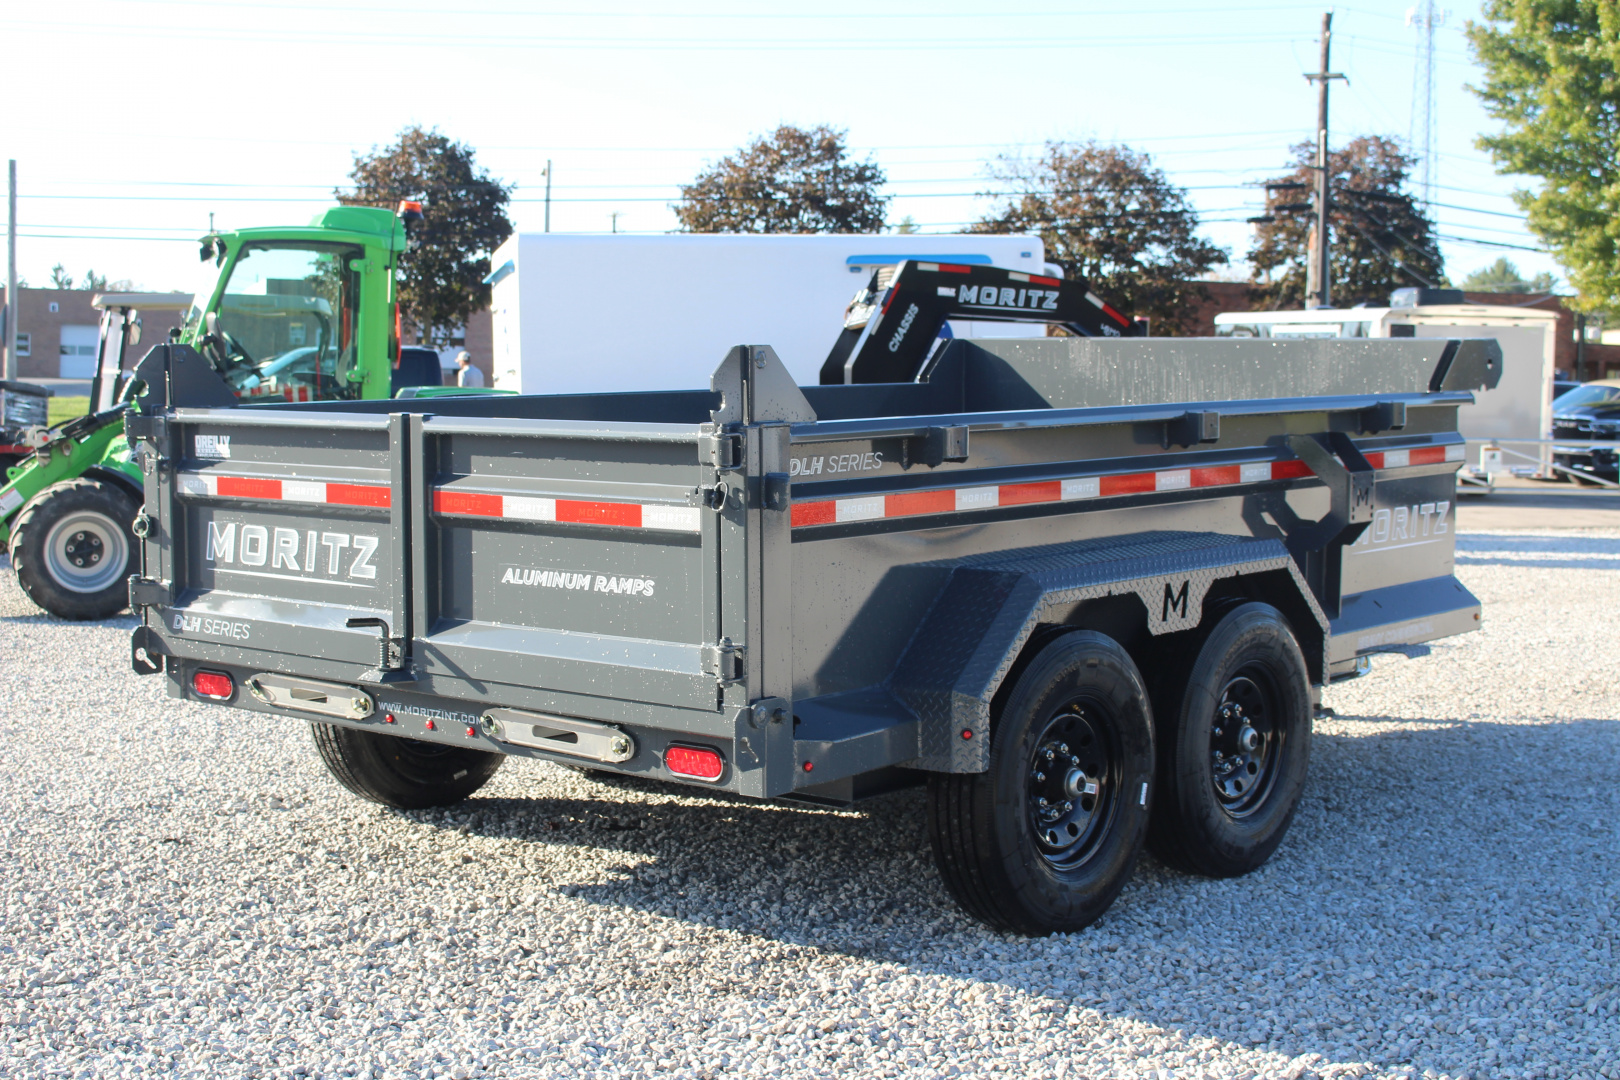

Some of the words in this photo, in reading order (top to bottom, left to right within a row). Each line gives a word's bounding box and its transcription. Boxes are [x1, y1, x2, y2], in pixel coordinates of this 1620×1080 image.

[958, 284, 1060, 310] MORITZ
[888, 302, 919, 352] CHASSIS
[789, 456, 825, 477] DLH
[826, 451, 884, 473] SERIES
[288, 486, 320, 497] MORITZ
[345, 490, 378, 501] MORITZ
[1065, 483, 1095, 494] MORITZ
[1356, 487, 1369, 507] M
[962, 492, 993, 503] MORITZ
[510, 501, 548, 514] MORITZ
[578, 507, 618, 520] MORITZ
[842, 502, 879, 515] MORITZ
[650, 511, 694, 525] MORITZ
[206, 521, 379, 579] MORITZ
[501, 568, 592, 591] ALUMINUM
[593, 575, 656, 597] RAMPS
[1162, 580, 1190, 622] M
[172, 614, 202, 632] DLH
[203, 618, 251, 640] SERIES
